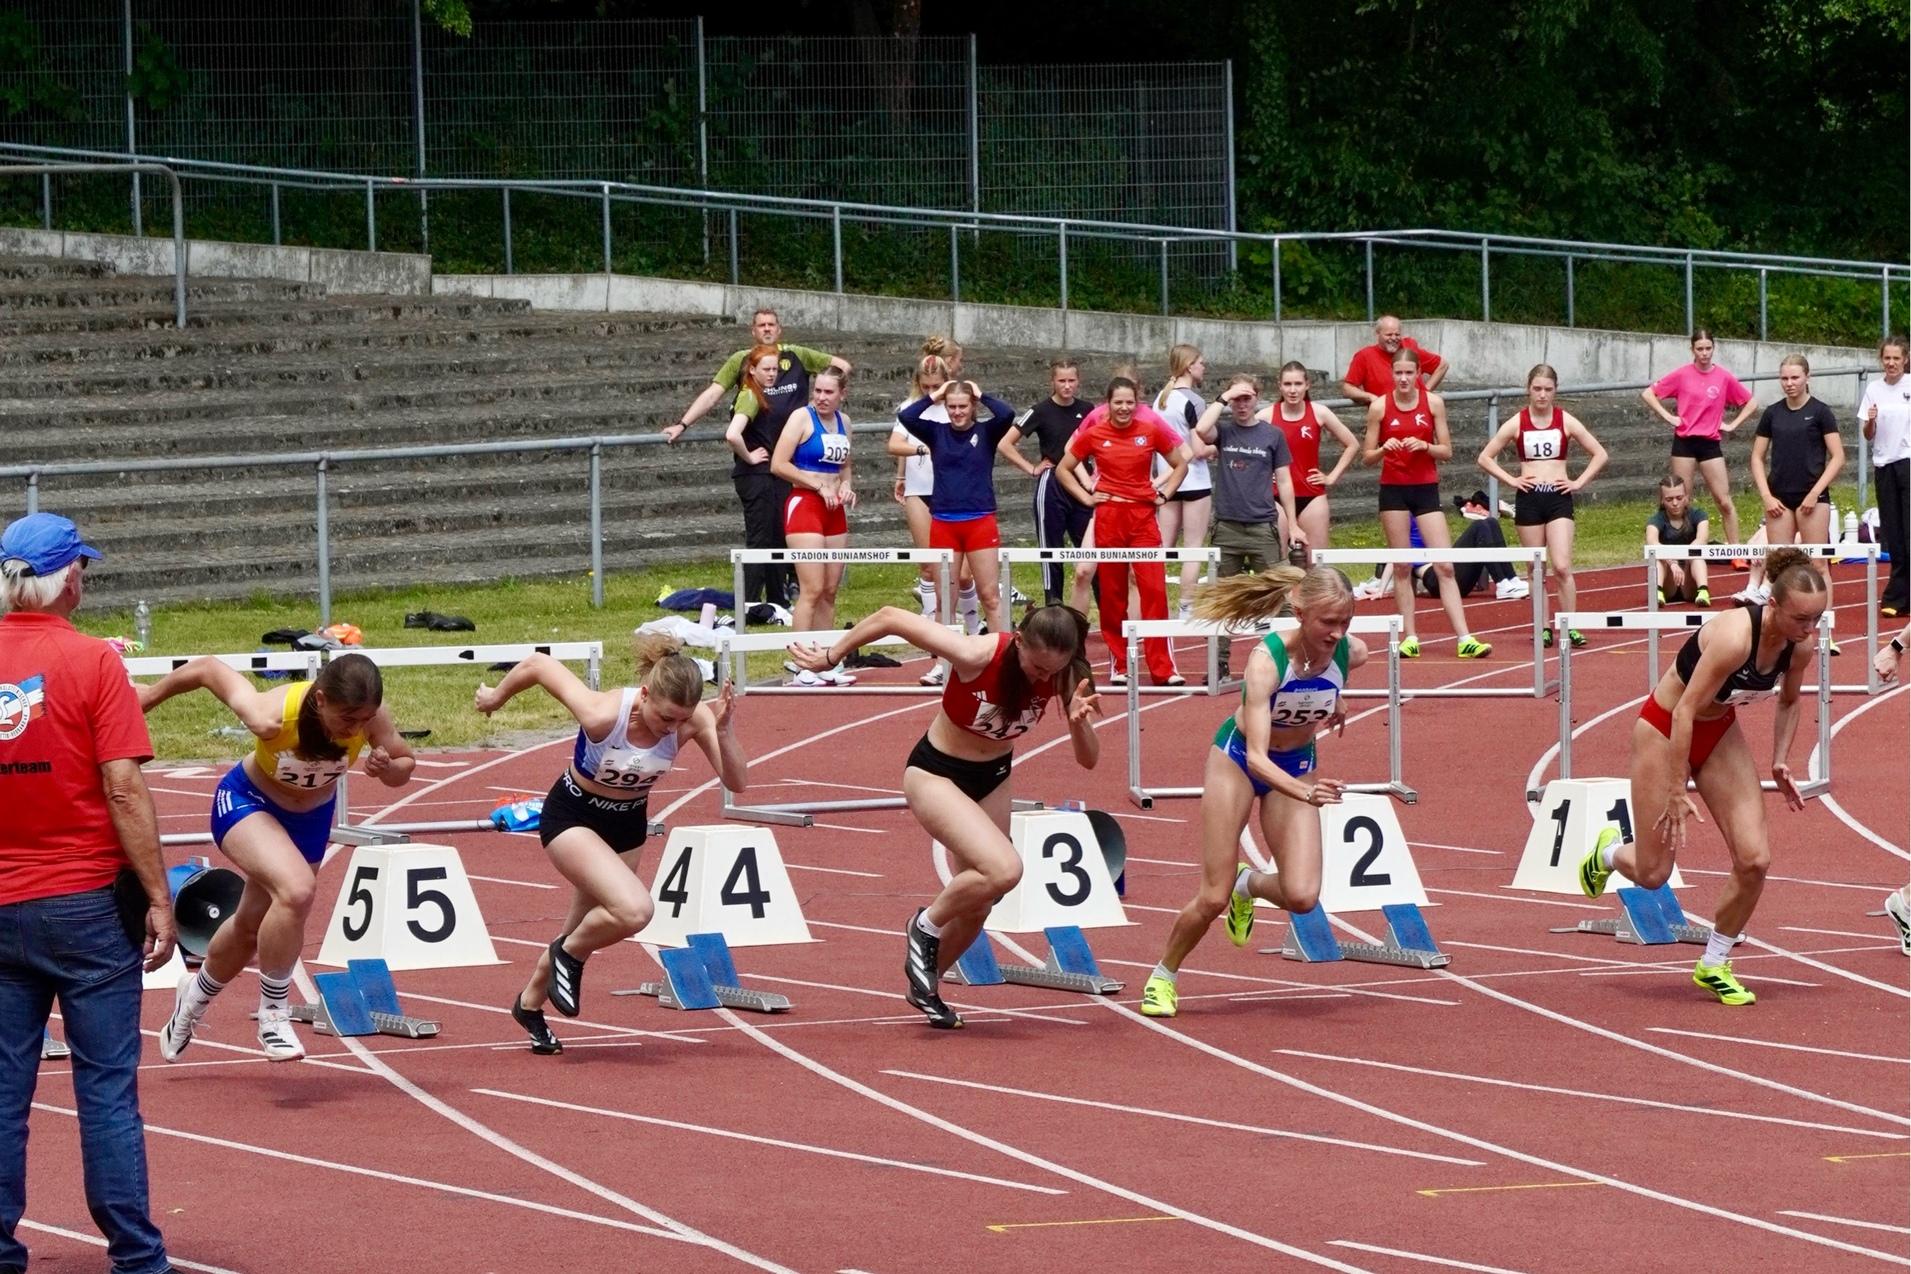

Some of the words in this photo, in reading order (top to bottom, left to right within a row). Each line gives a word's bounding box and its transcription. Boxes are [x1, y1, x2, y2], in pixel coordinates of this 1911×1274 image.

[826, 446, 849, 463] 203
[1533, 442, 1553, 458] 18
[790, 551, 829, 561] STADION
[831, 551, 890, 561] BUNIAMSHOF
[1059, 551, 1097, 560] STADION
[1100, 551, 1158, 560] BUNIAMSHOF
[1708, 547, 1749, 557] STADION
[280, 772, 341, 788] 217
[601, 769, 659, 786] 294
[588, 797, 632, 811] NIKE
[1550, 799, 1571, 867] 1
[1606, 798, 1634, 845] 1
[1343, 815, 1392, 887] 2
[658, 846, 693, 918] 4
[720, 847, 771, 919] 4
[1042, 832, 1092, 907] 3
[342, 866, 379, 942] 5
[406, 866, 456, 943] 5
